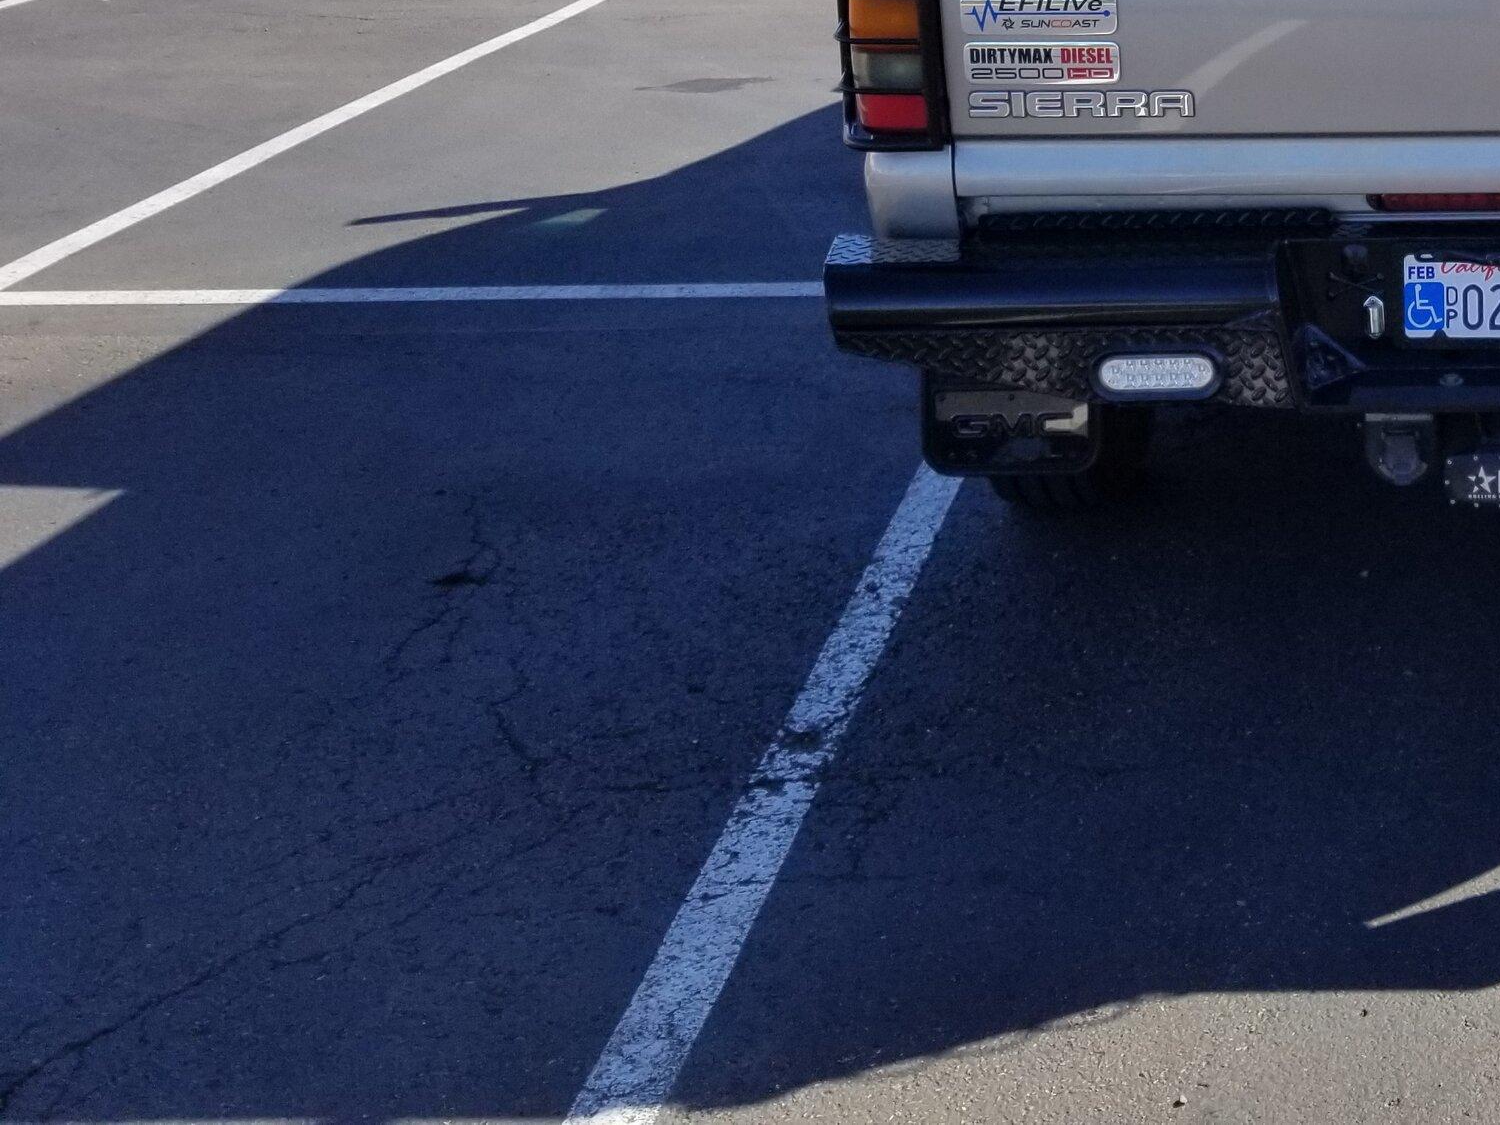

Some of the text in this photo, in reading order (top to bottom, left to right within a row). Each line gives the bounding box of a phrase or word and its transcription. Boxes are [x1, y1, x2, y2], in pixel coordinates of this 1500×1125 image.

[1020, 19, 1101, 29] SUNCOAST
[969, 47, 1114, 65] DIRTYMAX DIESEL
[968, 90, 1196, 118] SIERRA
[1408, 266, 1435, 280] FEB
